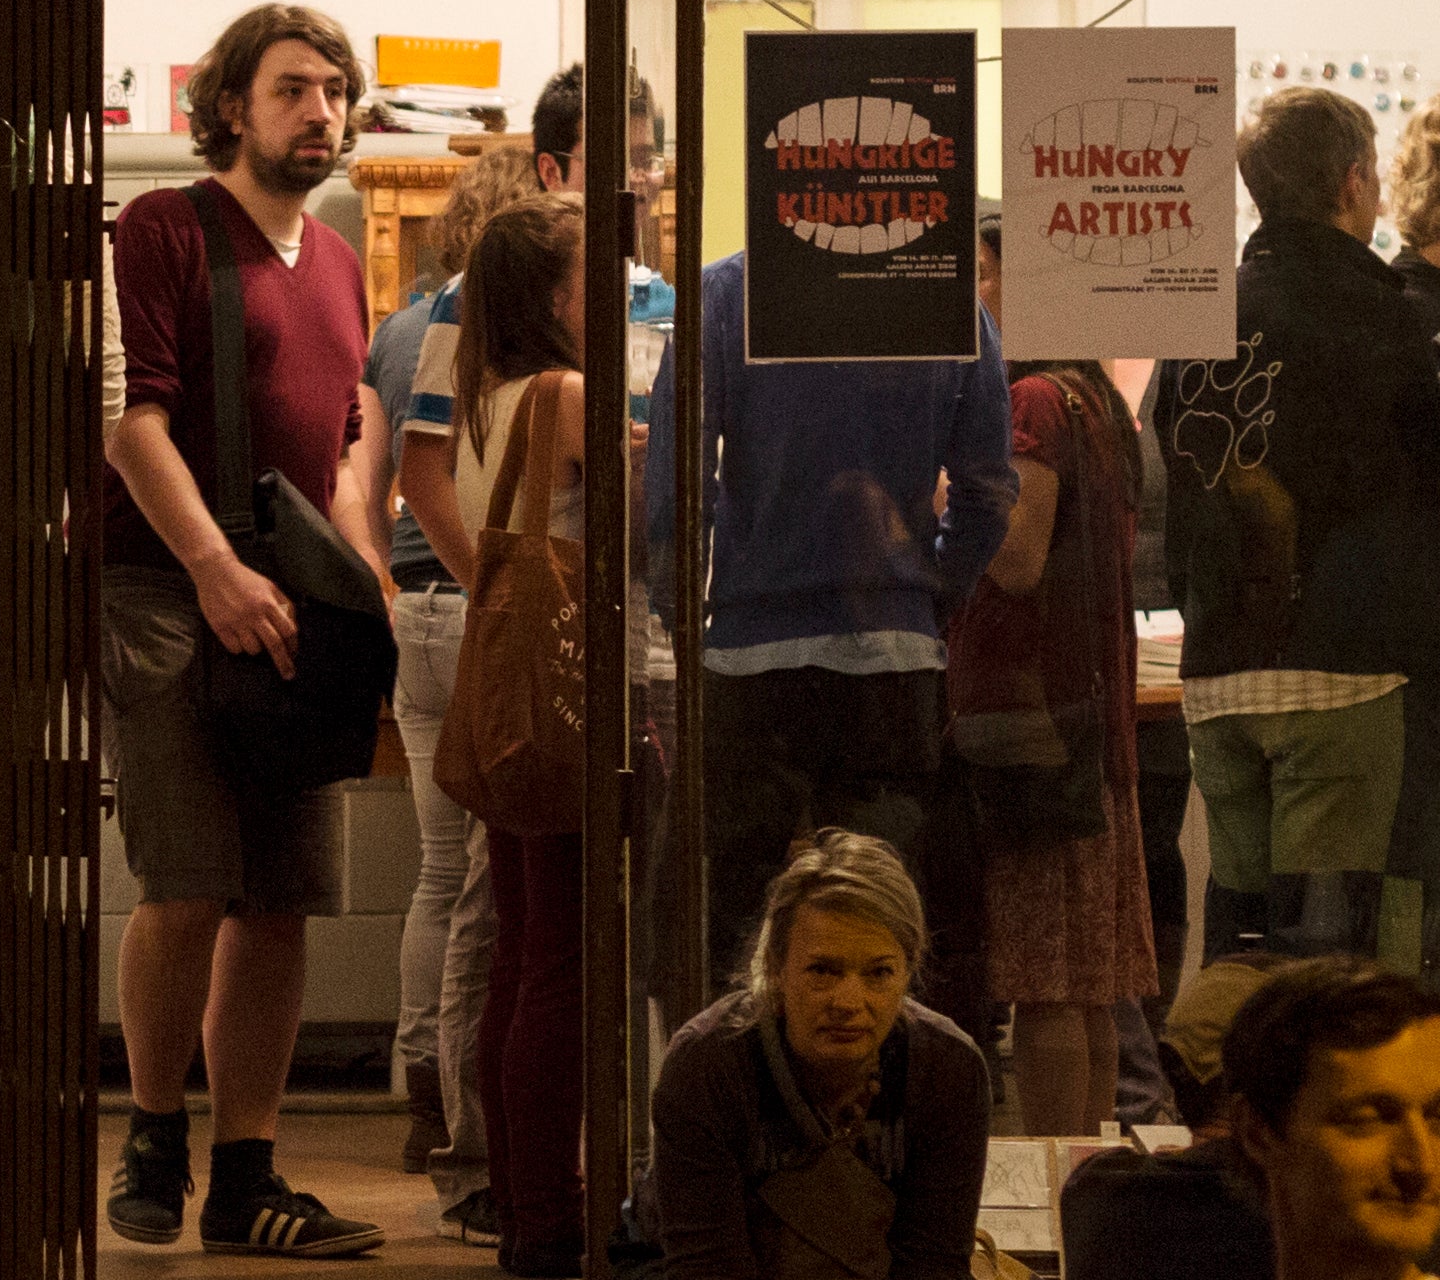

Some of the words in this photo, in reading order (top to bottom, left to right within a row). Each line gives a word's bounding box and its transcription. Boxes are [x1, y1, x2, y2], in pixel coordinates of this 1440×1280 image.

[933, 84, 956, 94] BRN
[1194, 85, 1218, 94] BRN
[777, 137, 956, 170] HUNGRIGE
[1034, 143, 1192, 178] HUNGRY
[880, 174, 938, 184] BARCELONA
[1092, 185, 1120, 193] FROM
[1123, 184, 1185, 193] BARCELONA
[777, 183, 949, 225] KÜNSTLER
[1047, 201, 1193, 236] ARTISTS
